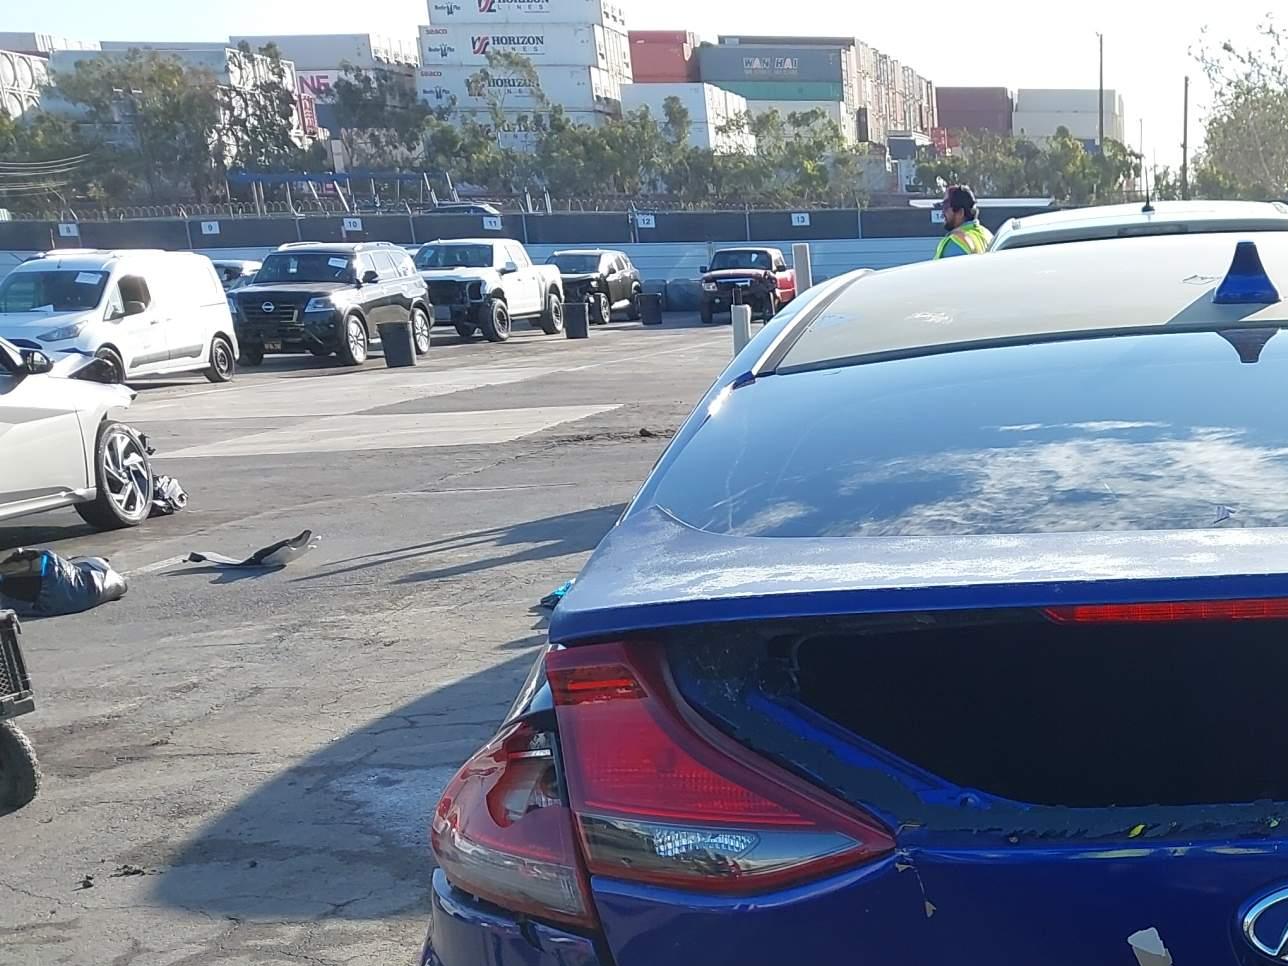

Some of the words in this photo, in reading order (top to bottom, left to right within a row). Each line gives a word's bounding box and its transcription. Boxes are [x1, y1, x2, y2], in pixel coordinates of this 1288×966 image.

[492, 36, 544, 45] HORIZON
[743, 57, 770, 68] WAN
[775, 57, 798, 68] HAI
[348, 220, 357, 228] 10
